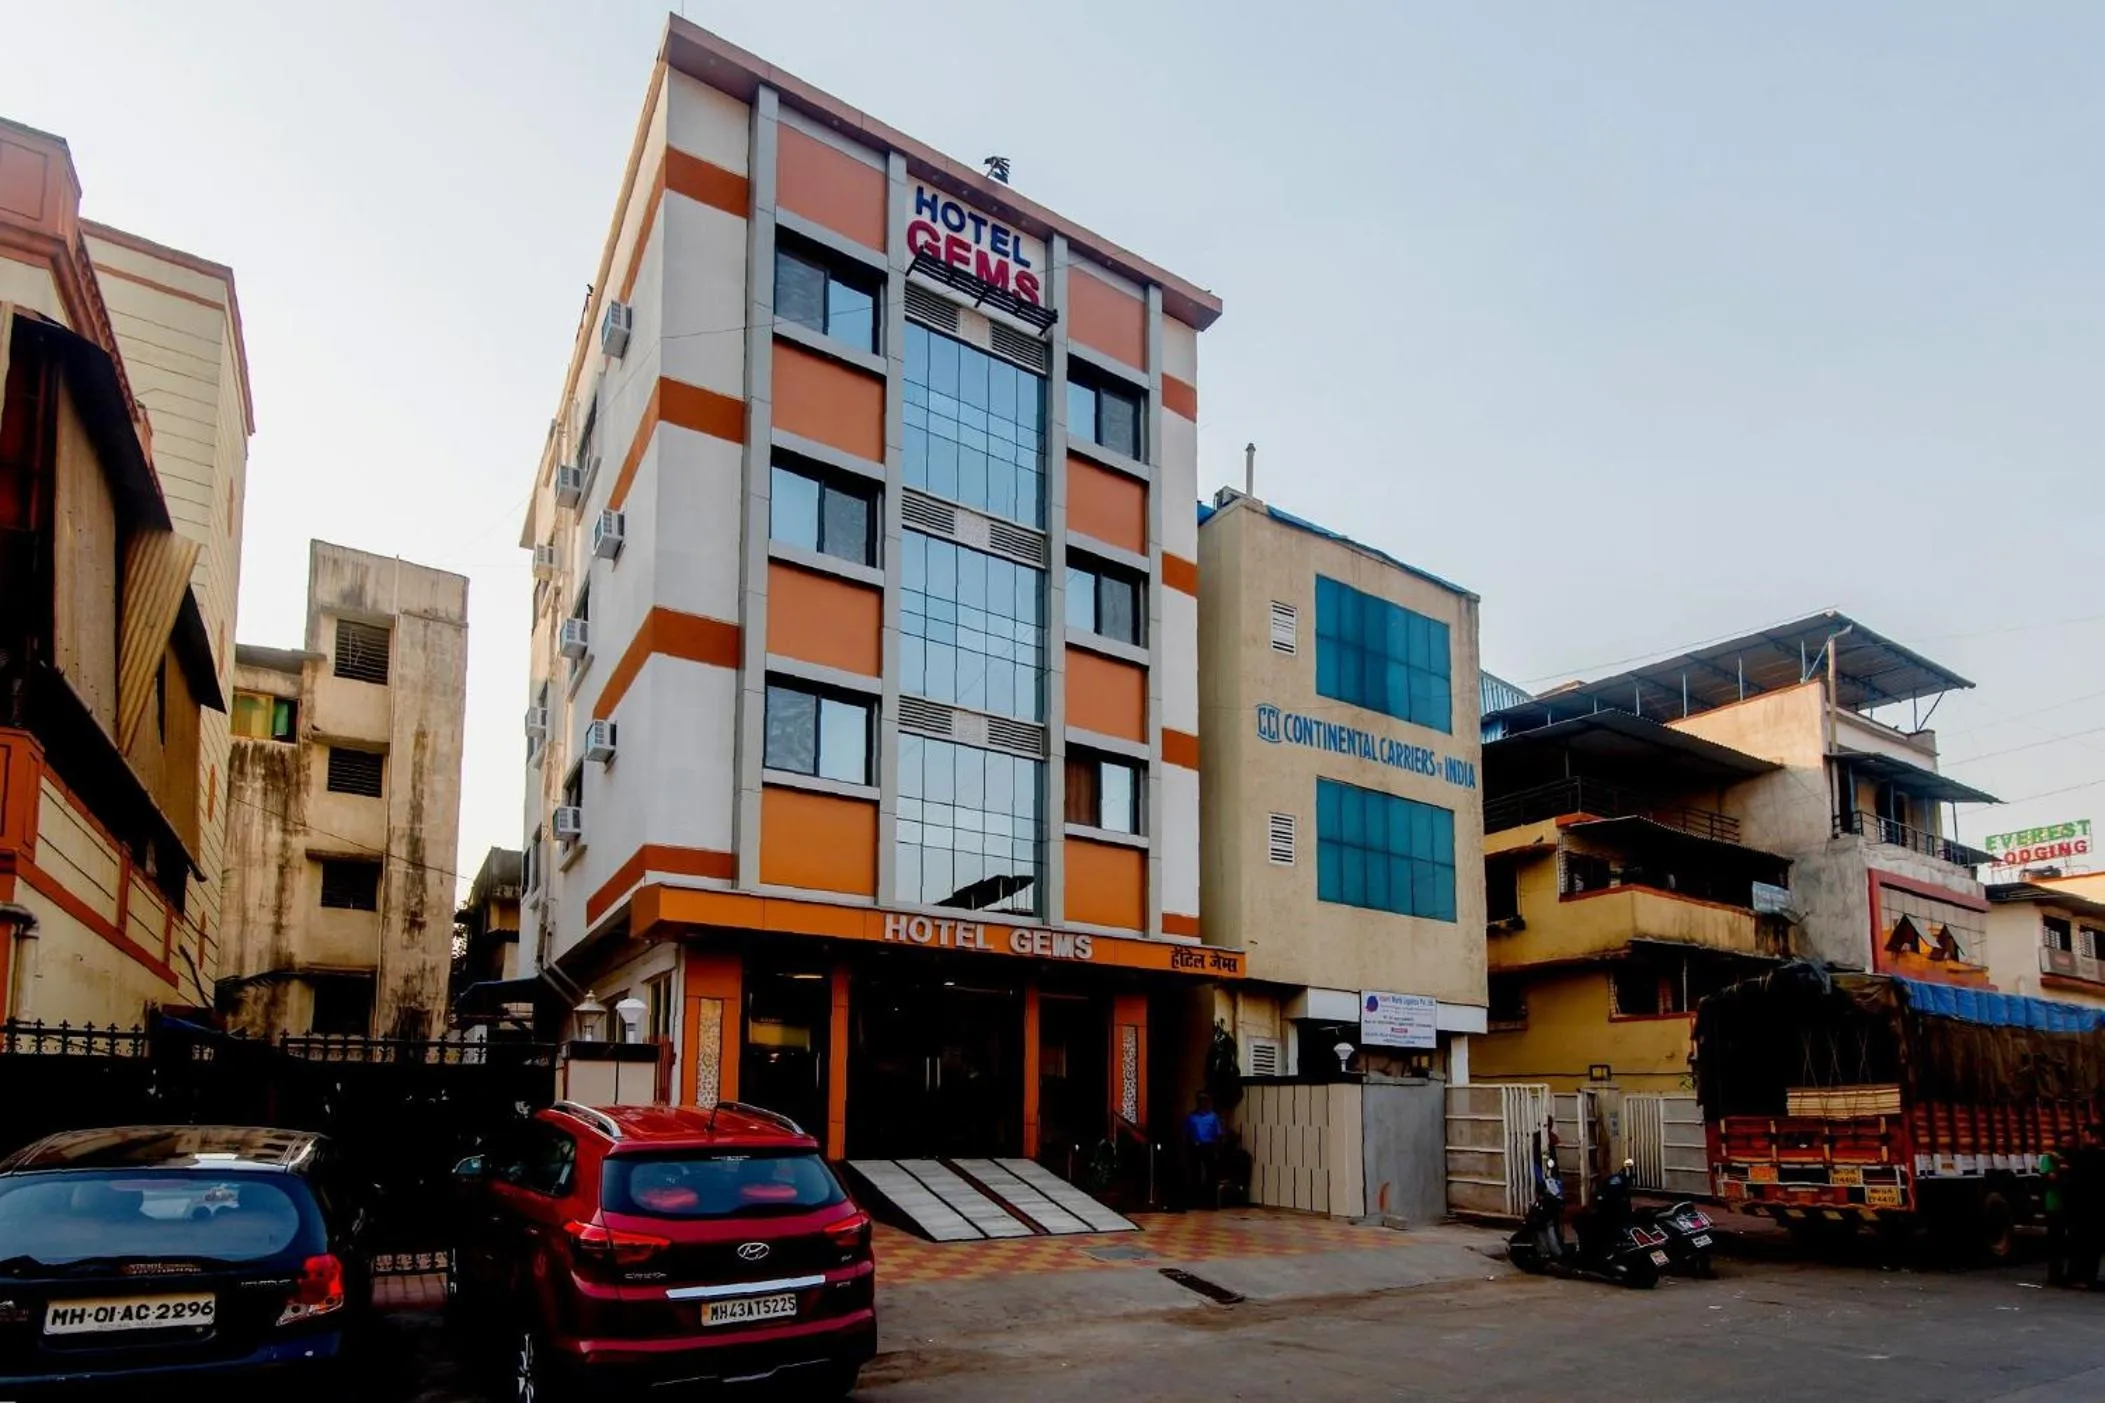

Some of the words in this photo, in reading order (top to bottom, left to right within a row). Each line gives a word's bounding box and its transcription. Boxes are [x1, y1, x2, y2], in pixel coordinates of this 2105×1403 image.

[915, 185, 1031, 269] HOTEL
[907, 220, 1040, 306] GEMS
[1284, 713, 1377, 761] CONTINENTAL
[1380, 737, 1436, 776] CARRIERS
[1444, 756, 1476, 789] INDIA
[1985, 819, 2090, 850] EVEREST
[884, 914, 995, 950] HOTEL
[1009, 928, 1093, 960] GEMS
[709, 1296, 796, 1321] MH43AT5225
